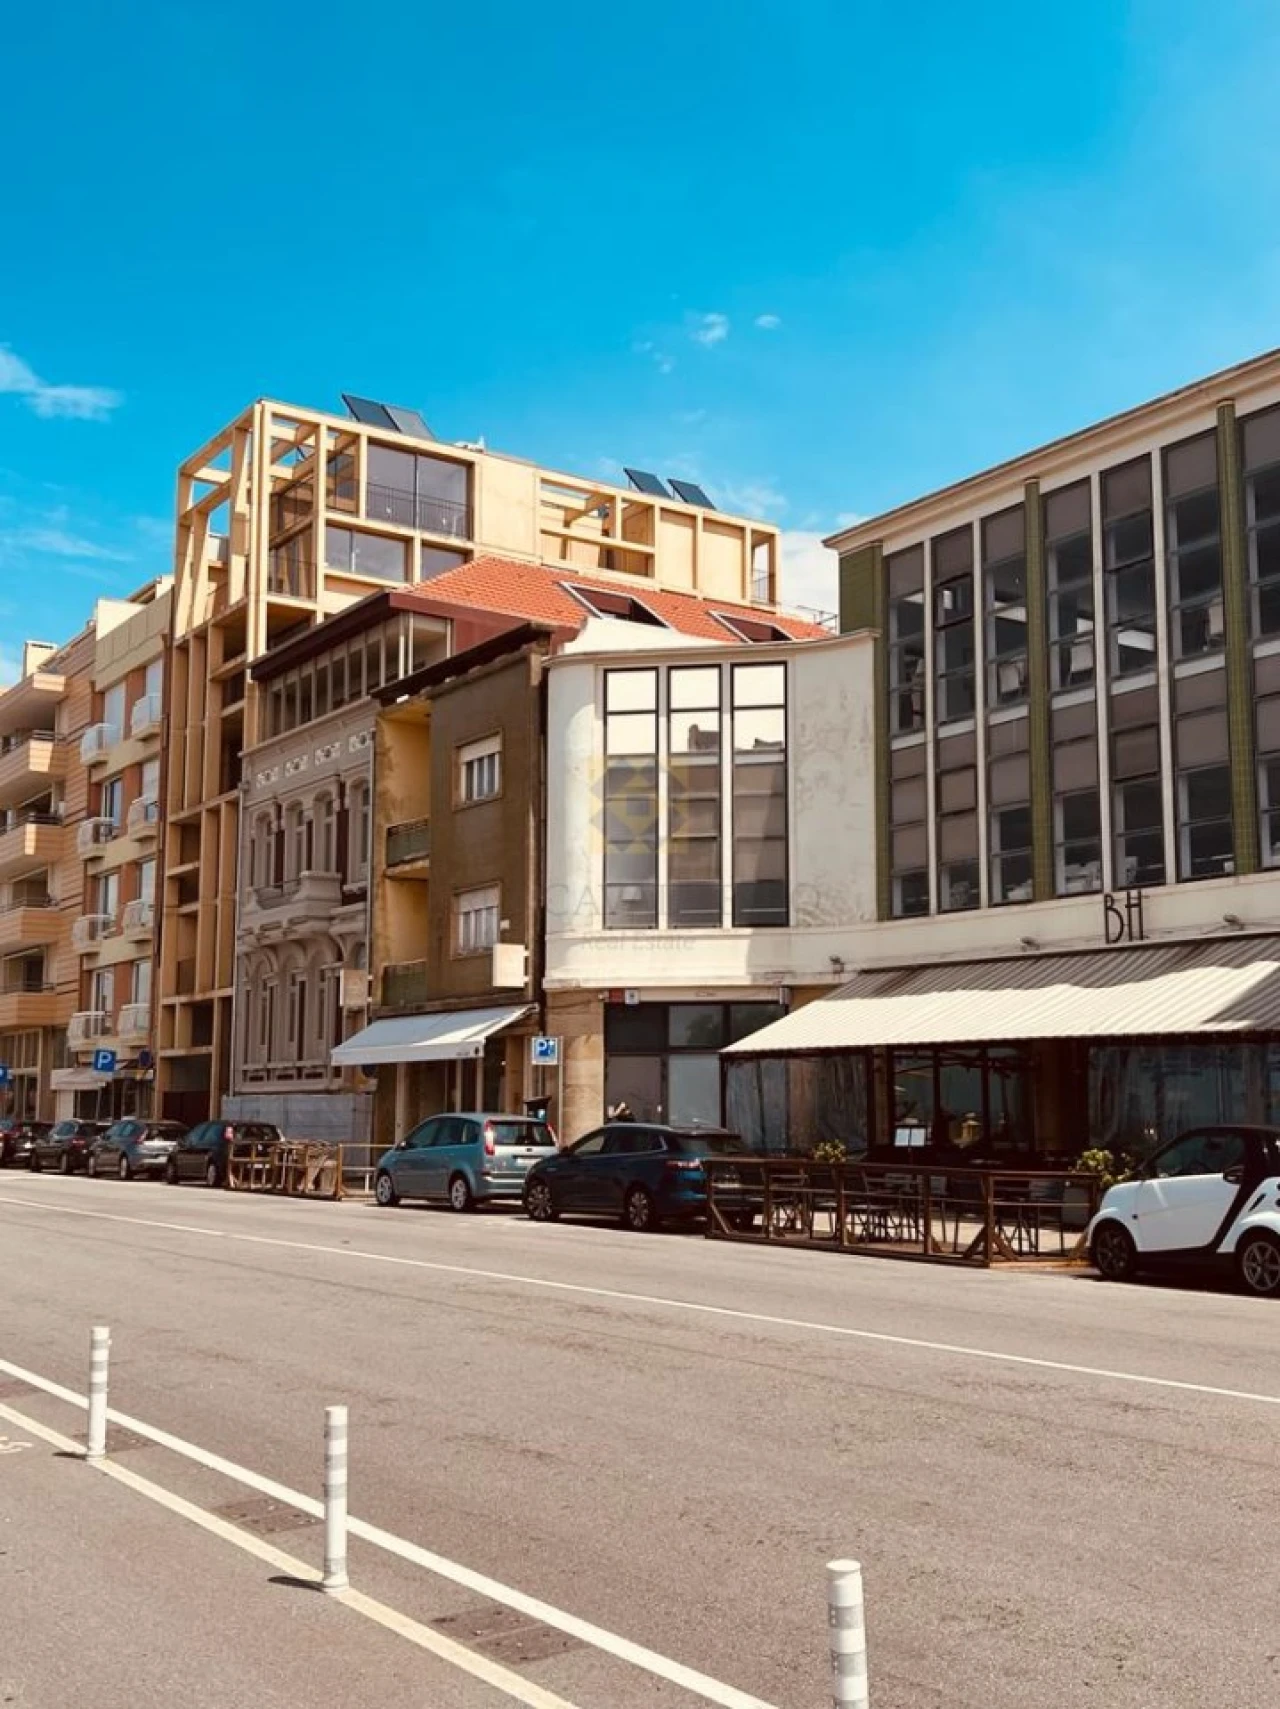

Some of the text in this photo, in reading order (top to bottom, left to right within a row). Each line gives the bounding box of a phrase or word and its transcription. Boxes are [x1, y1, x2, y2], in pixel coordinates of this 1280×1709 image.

[1104, 890, 1143, 944] BH
[536, 1039, 548, 1056] P
[97, 1051, 112, 1069] P
